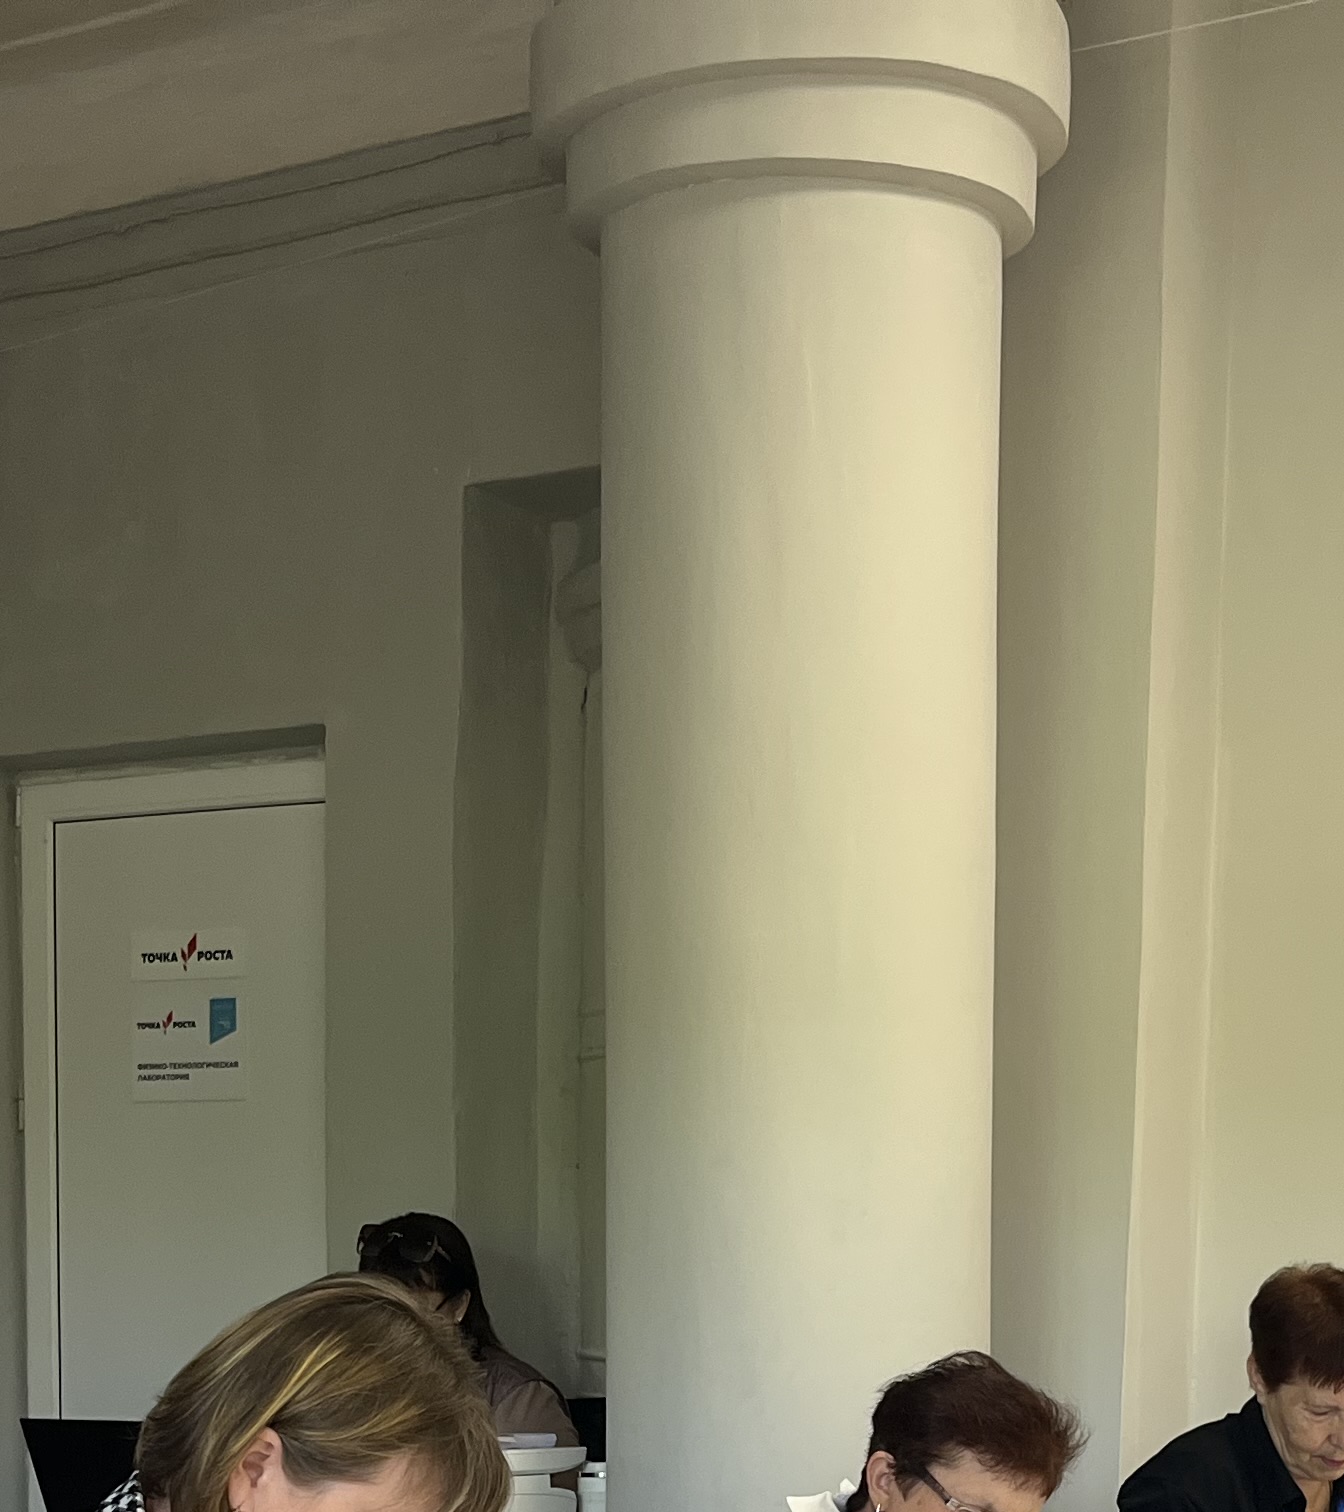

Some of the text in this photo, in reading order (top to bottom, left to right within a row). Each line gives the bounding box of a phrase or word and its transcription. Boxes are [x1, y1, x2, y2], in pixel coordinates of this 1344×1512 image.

[140, 949, 234, 965] ТОЧКА РОСТА
[136, 1020, 197, 1031] ТОЧКА РОСТА
